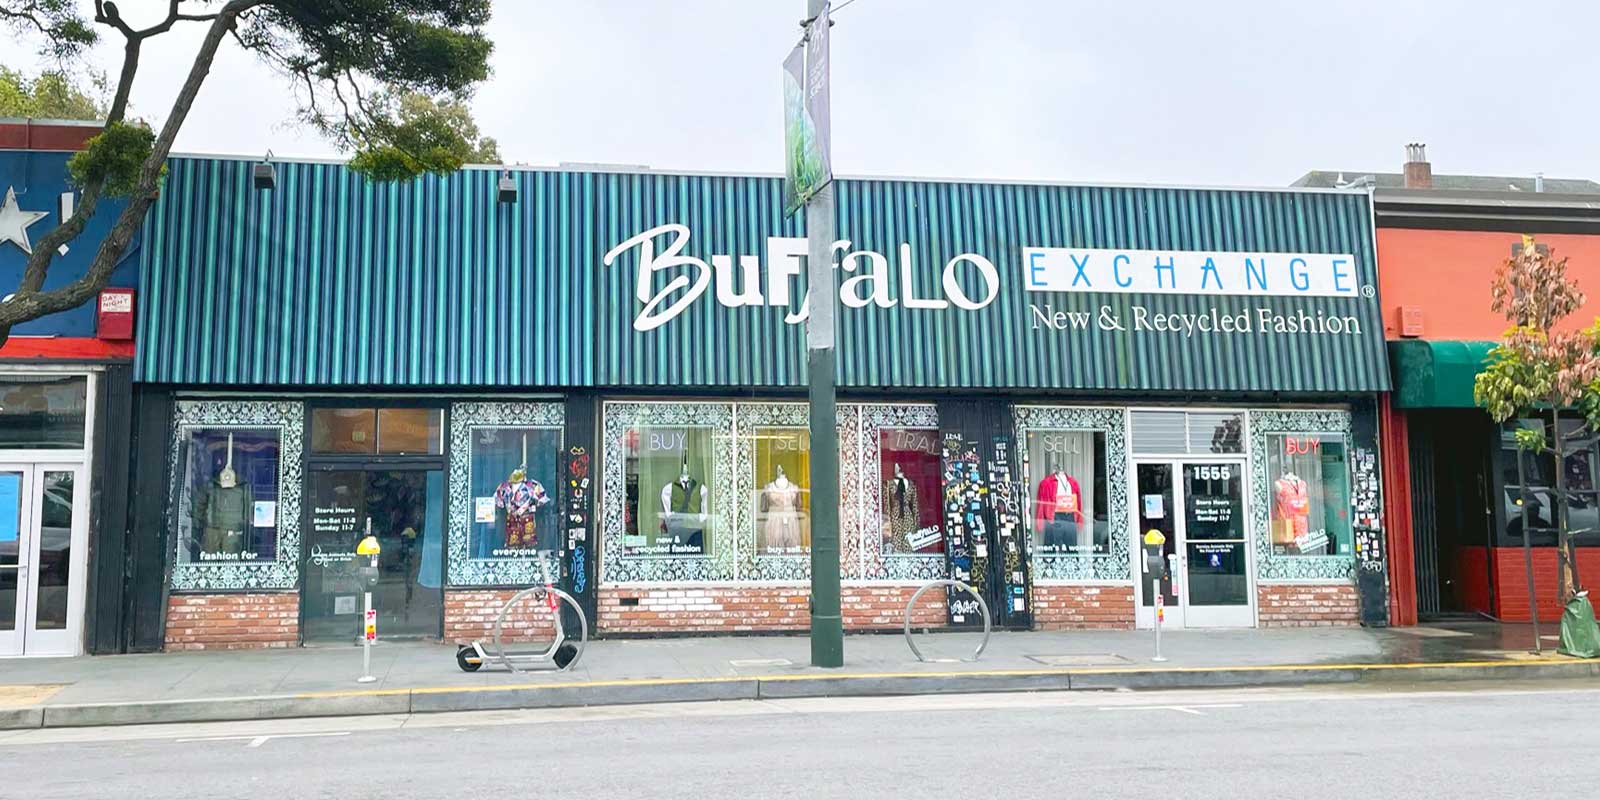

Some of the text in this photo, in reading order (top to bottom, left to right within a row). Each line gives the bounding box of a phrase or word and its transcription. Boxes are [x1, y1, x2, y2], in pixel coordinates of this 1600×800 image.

[1029, 252, 1351, 292] EXCHANGE
[102, 299, 128, 307] NIGHT
[1029, 304, 1363, 338] New & Recycled Fashion
[649, 432, 687, 451] BUY
[1043, 434, 1081, 454] SELL
[1286, 436, 1320, 455] BUY
[1193, 466, 1231, 480] 1555
[199, 550, 258, 560] fashion for
[492, 548, 537, 558] everyone
[634, 543, 702, 554] recycled fashion
